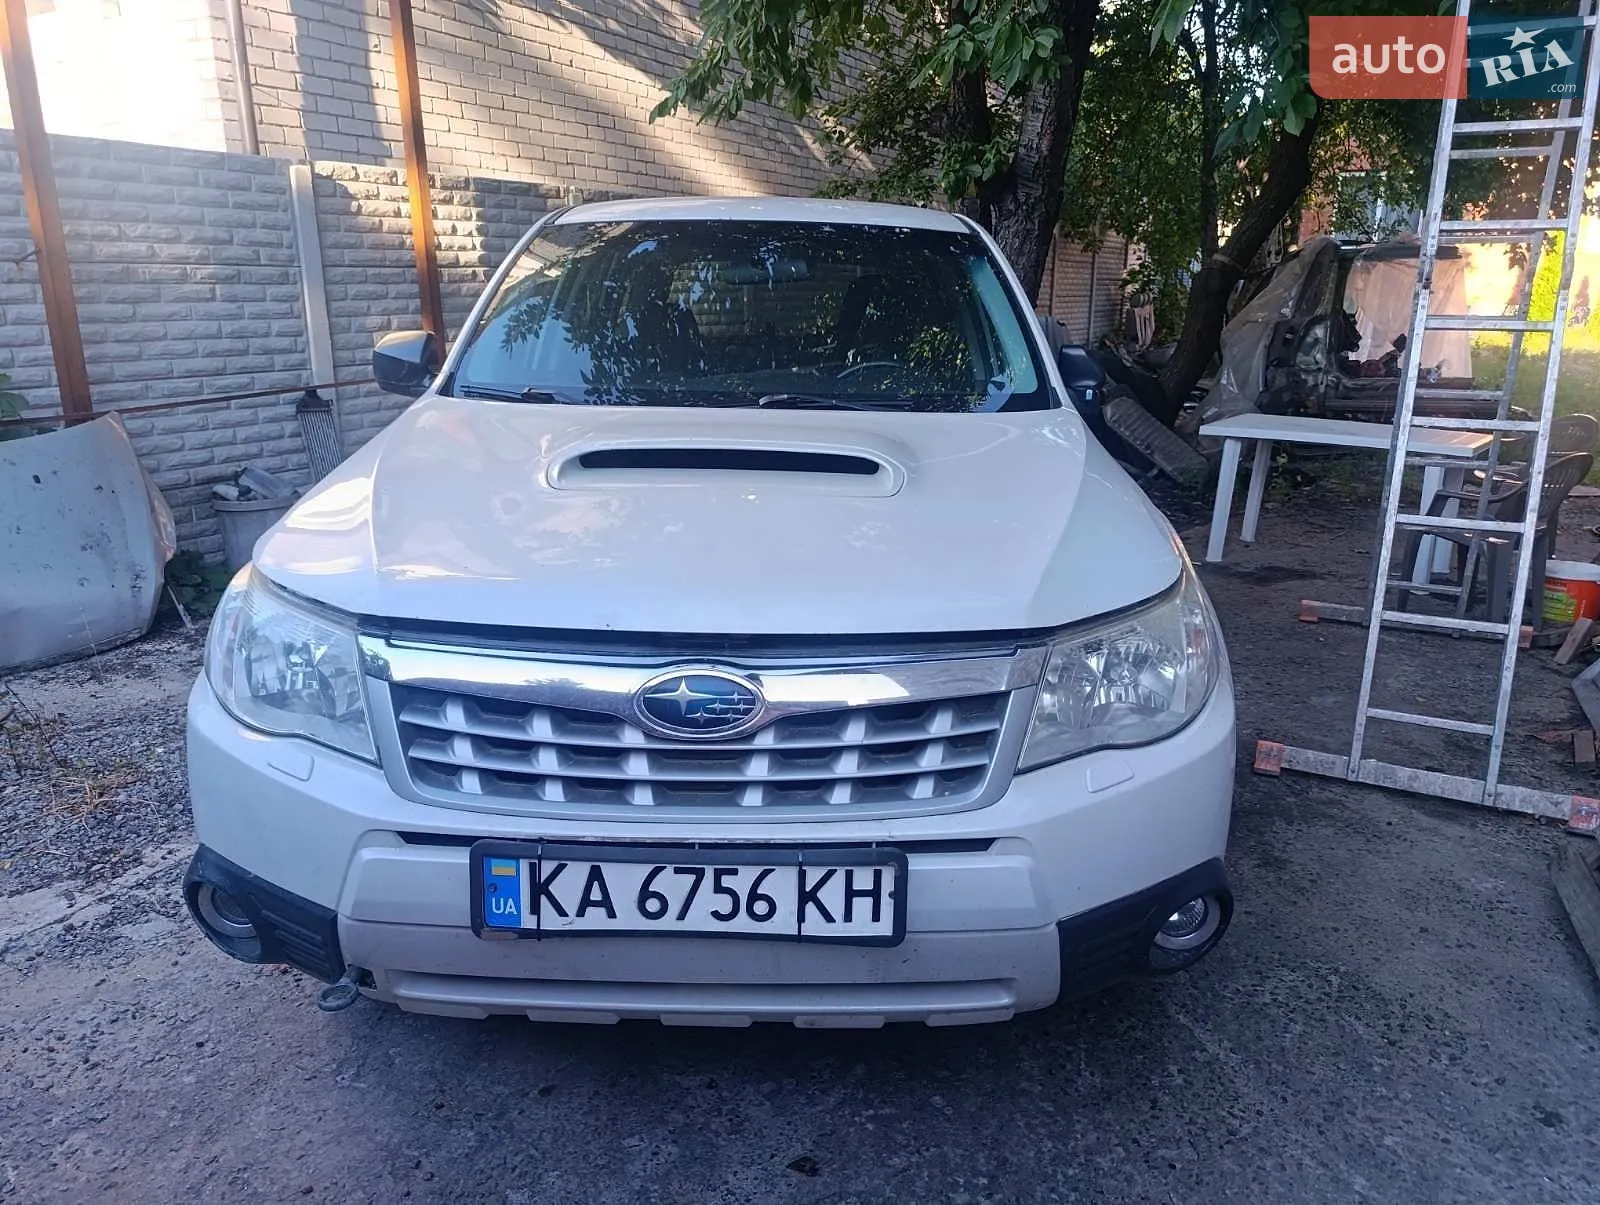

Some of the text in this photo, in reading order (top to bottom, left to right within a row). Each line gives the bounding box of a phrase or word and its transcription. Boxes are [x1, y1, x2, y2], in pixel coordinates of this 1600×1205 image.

[492, 898, 517, 915] UA
[528, 861, 882, 924] KA 6756 KH
